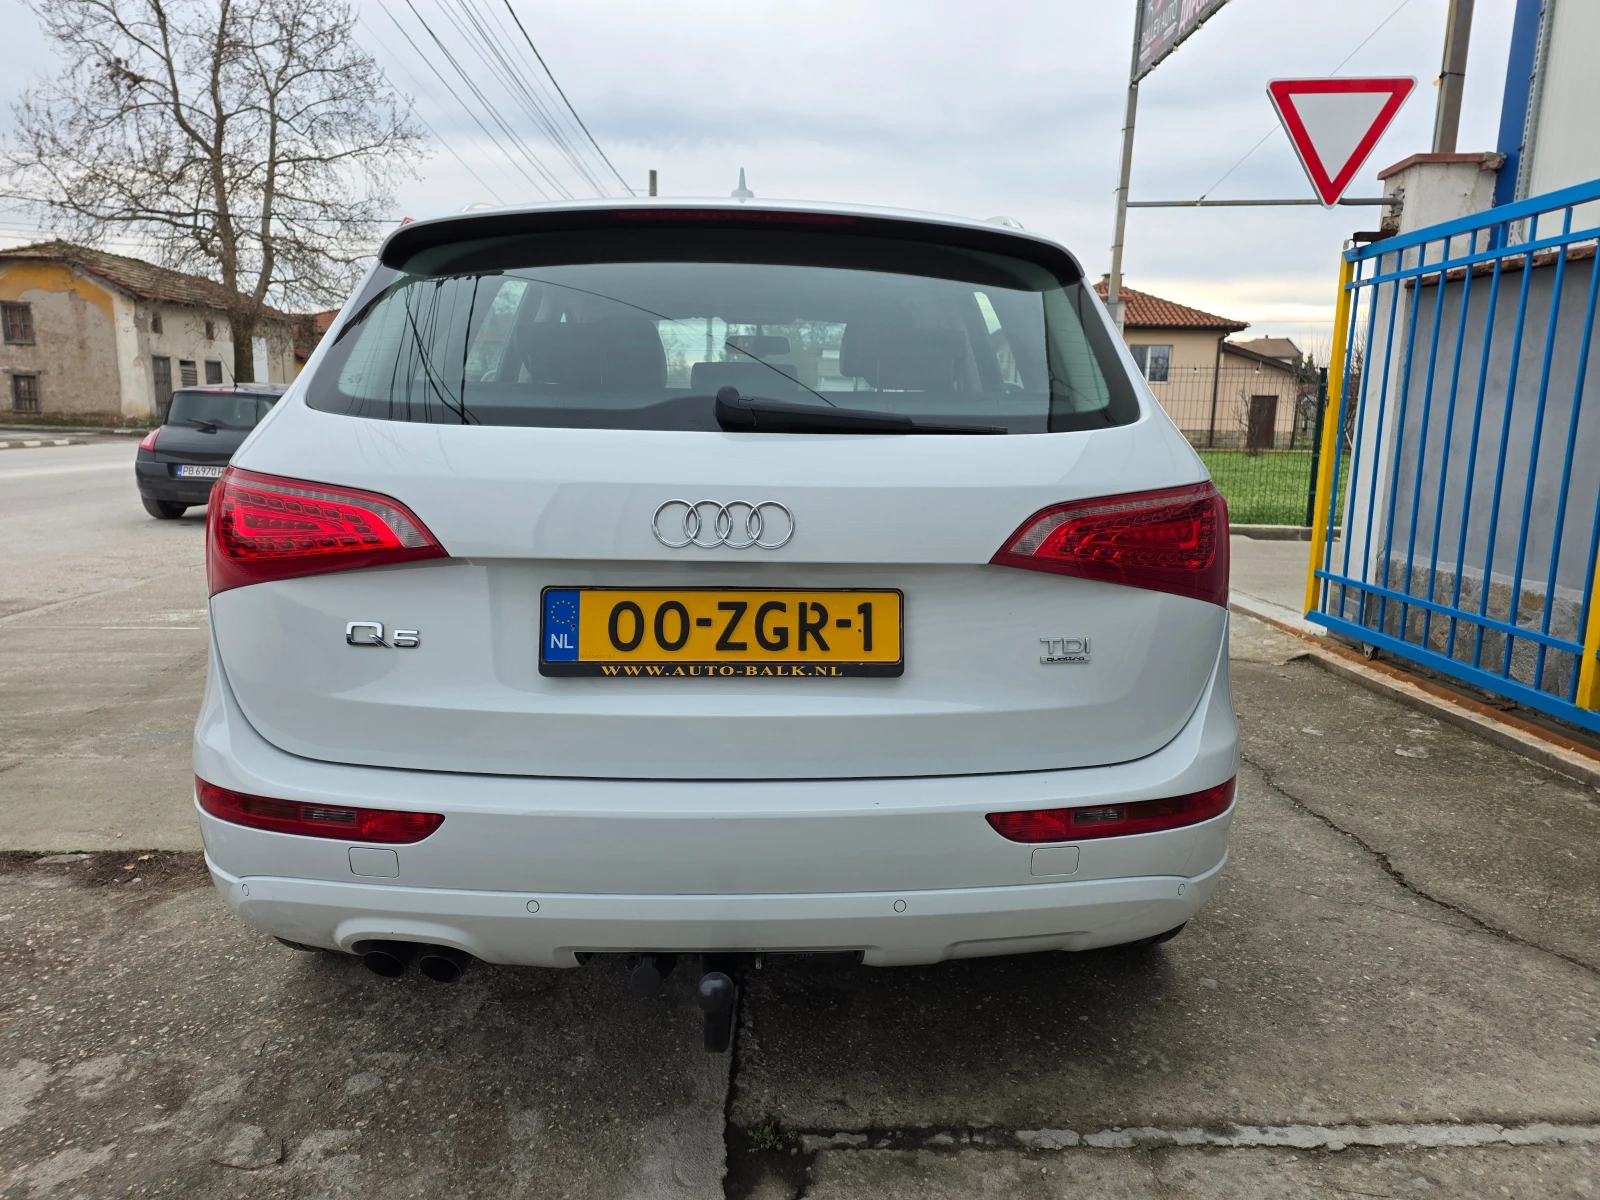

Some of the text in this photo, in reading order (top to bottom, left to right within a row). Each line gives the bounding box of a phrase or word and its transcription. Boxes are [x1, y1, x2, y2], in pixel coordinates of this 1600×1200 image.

[1160, 0, 1177, 32] AUTO
[195, 467, 217, 476] 6970
[346, 621, 421, 649] Q5
[608, 600, 873, 652] 00-ZGR-1
[550, 633, 574, 649] NL
[1040, 637, 1090, 655] TDI
[600, 665, 844, 677] WWW.AUTO-BALK.NL
